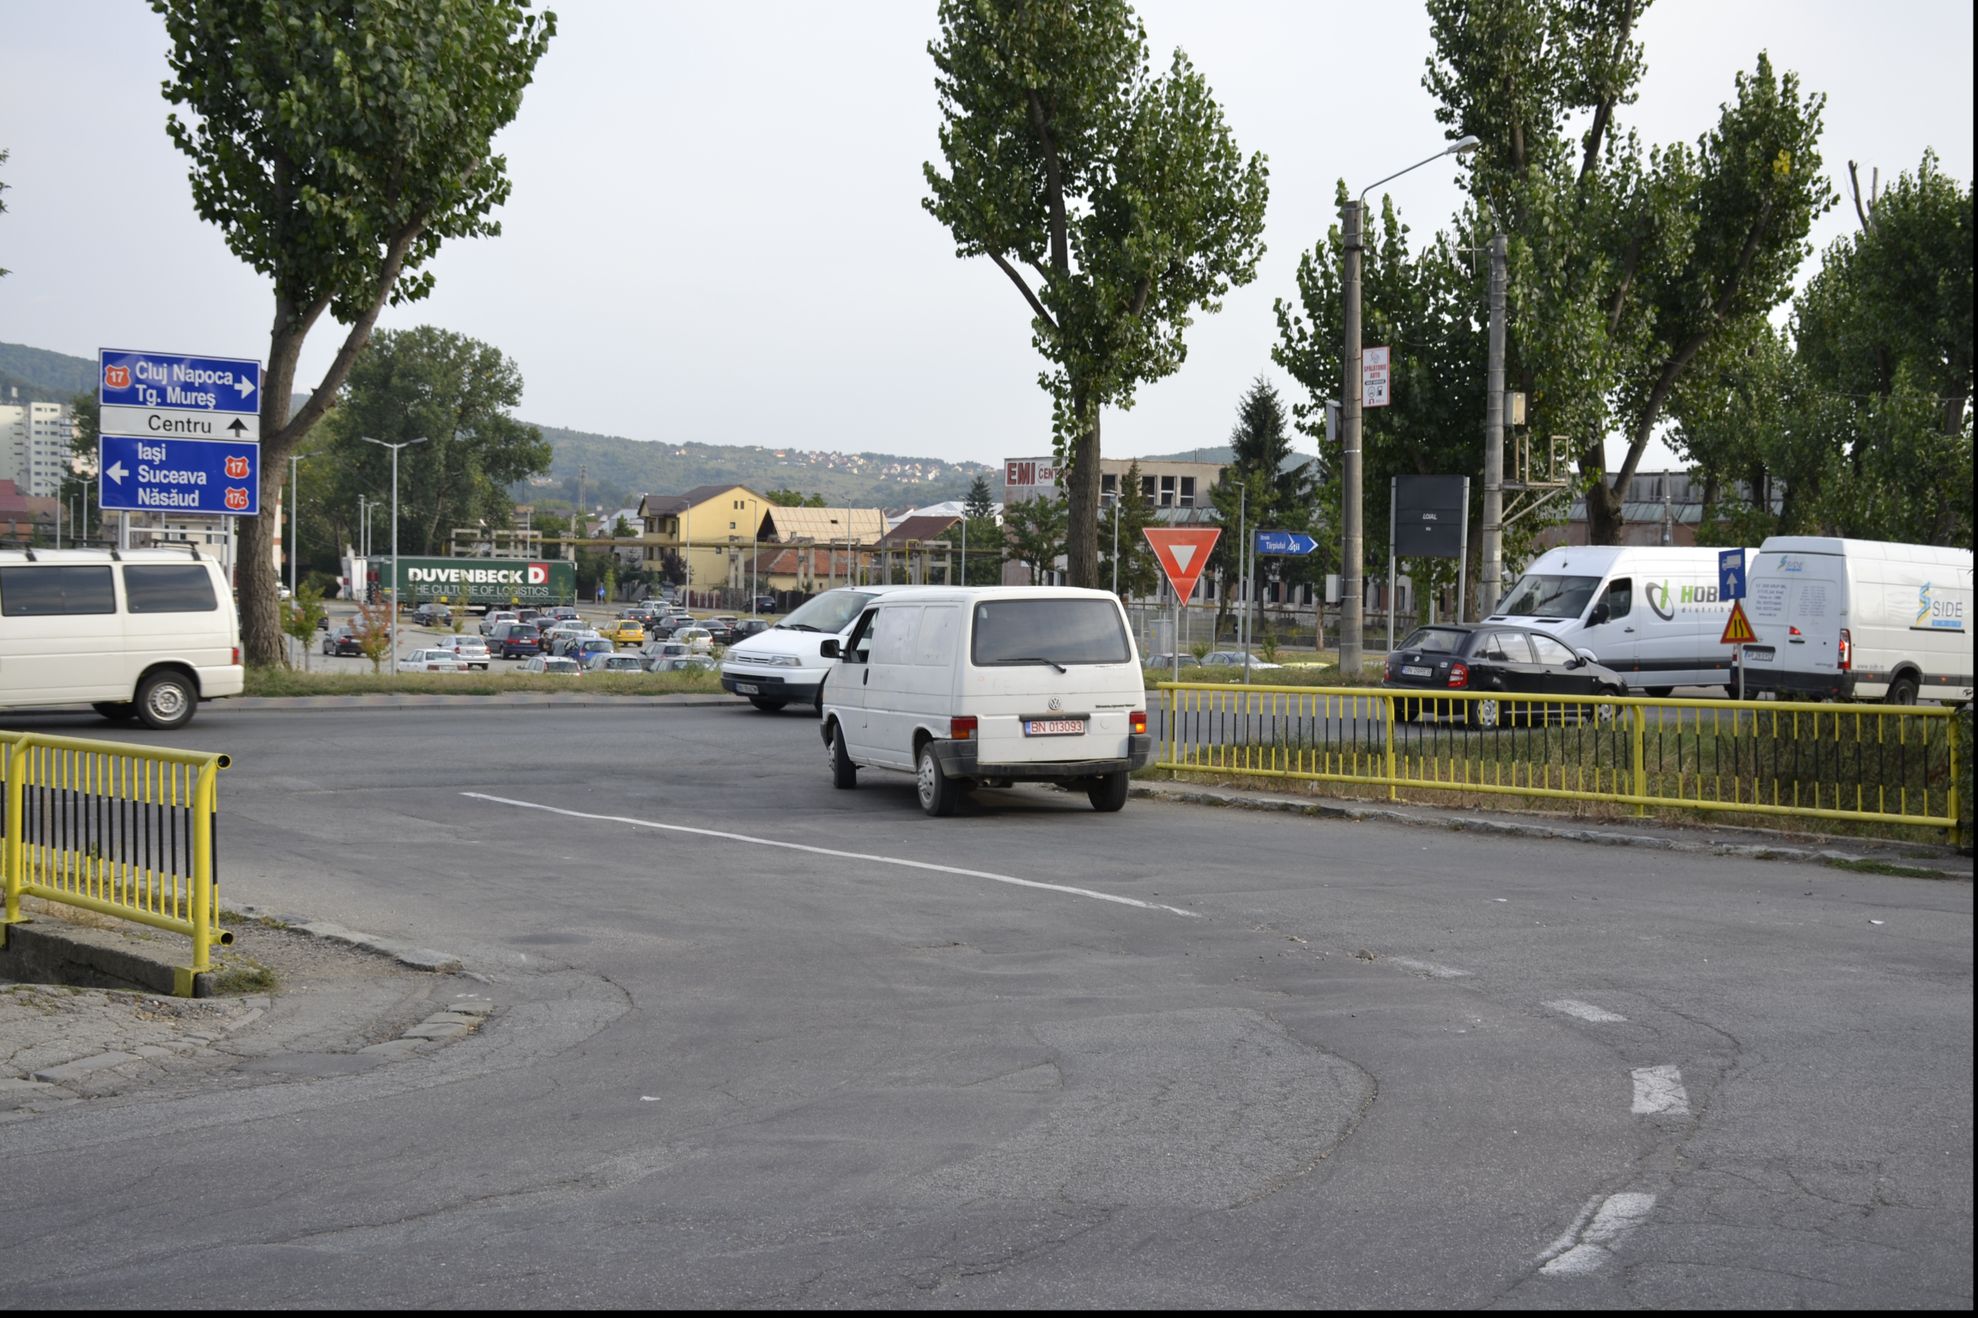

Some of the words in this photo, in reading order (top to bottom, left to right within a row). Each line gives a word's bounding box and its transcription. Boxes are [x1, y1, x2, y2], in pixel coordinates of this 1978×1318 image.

[110, 370, 123, 383] 17
[135, 361, 167, 384] Cluj
[173, 364, 233, 386] Napoca
[135, 384, 161, 407] Tg.
[148, 415, 211, 434] Centru
[138, 465, 207, 485] Suceava
[229, 462, 242, 474] 17
[1007, 462, 1036, 485] EMI
[138, 488, 199, 507] Năsăud
[408, 568, 524, 584] DUVENBECK
[480, 585, 494, 595] OF
[1680, 585, 1719, 603] HOB
[1932, 600, 1963, 618] SIDE
[1031, 722, 1046, 732] BN
[1049, 720, 1082, 732] 013093
